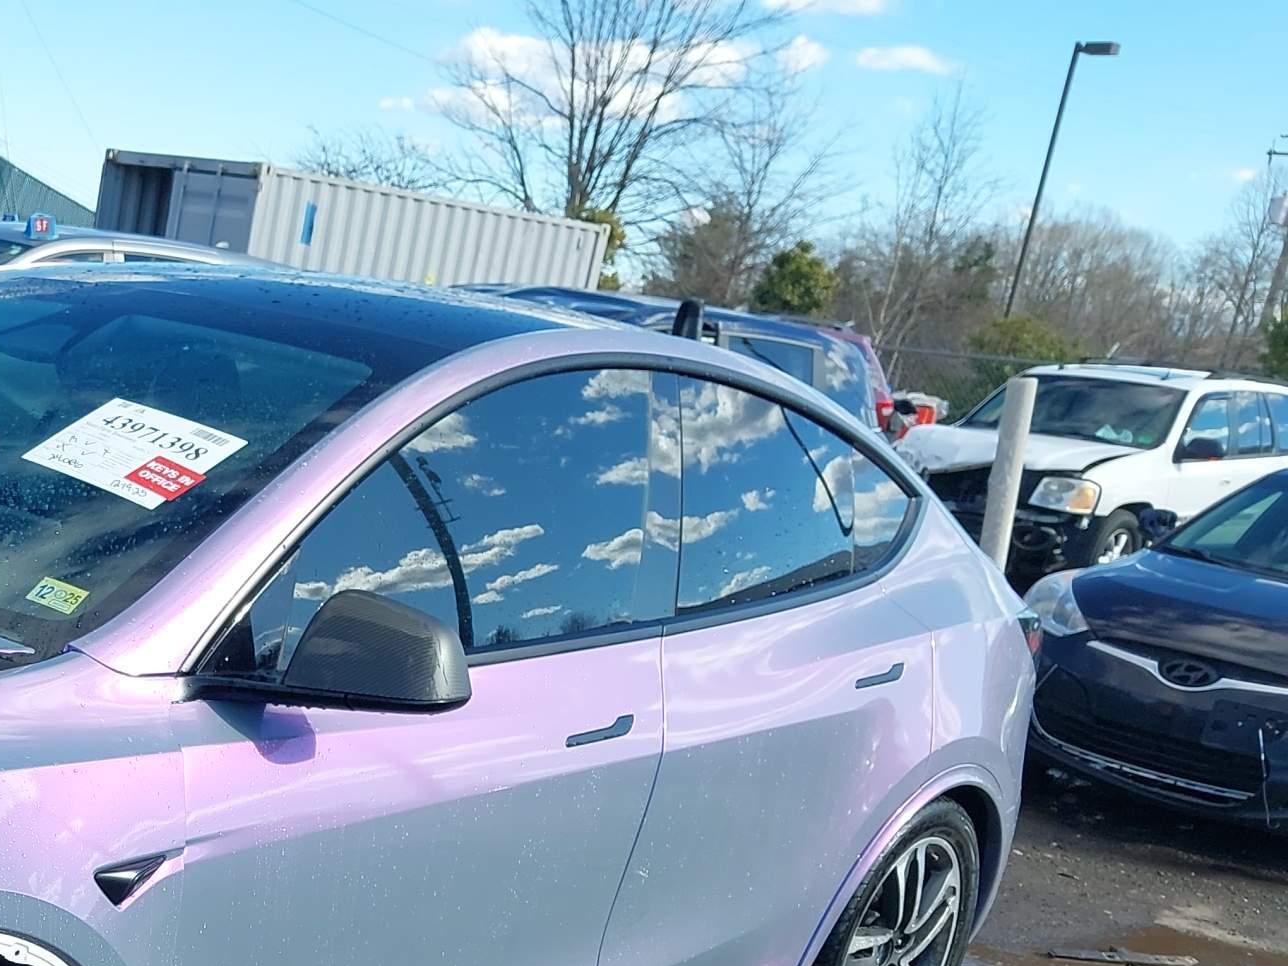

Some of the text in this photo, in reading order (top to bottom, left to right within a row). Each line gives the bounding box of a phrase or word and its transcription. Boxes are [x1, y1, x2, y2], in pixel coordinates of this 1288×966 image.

[35, 220, 48, 232] SF
[103, 415, 209, 461] 43971398
[138, 470, 181, 493] OFFICE
[146, 461, 180, 479] KEYS
[177, 475, 195, 487] IN
[35, 584, 56, 600] 12
[63, 592, 82, 606] 25
